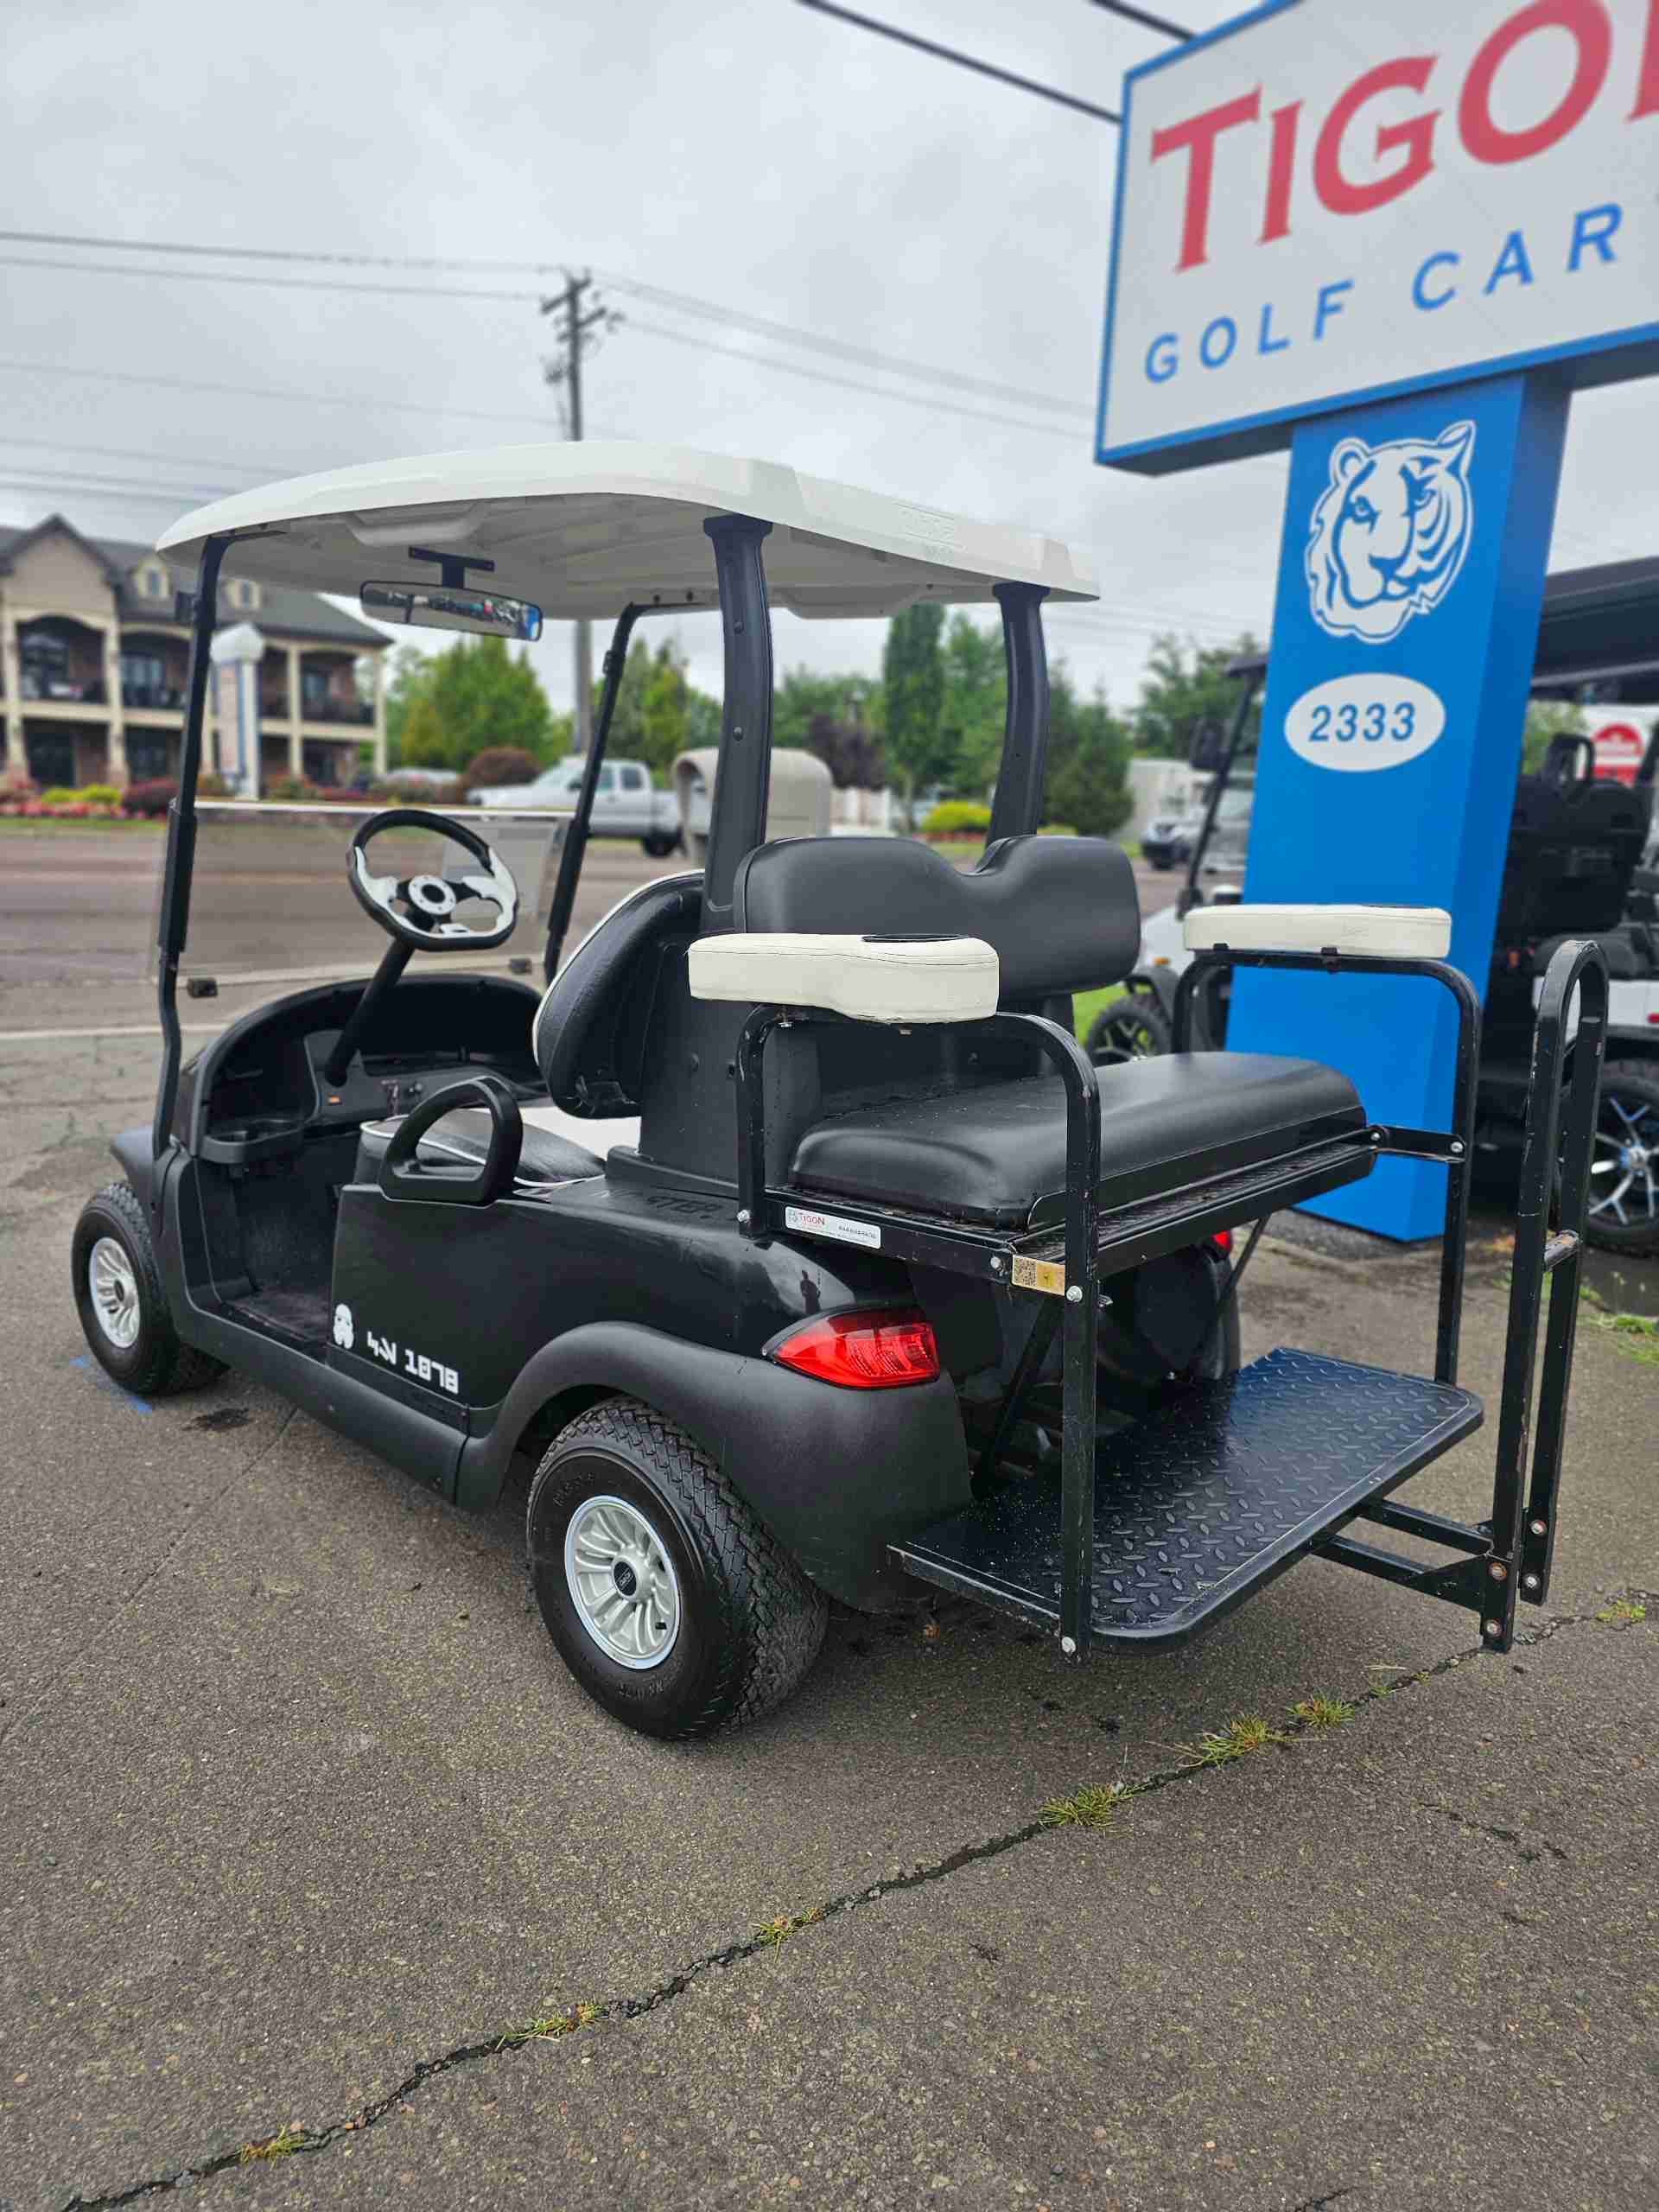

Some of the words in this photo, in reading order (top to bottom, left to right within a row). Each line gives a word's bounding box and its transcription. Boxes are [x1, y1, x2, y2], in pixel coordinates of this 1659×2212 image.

[1151, 0, 1659, 271] TIGO
[1143, 276, 1356, 385] GOLF
[1307, 700, 1417, 744] 2333
[404, 1348, 460, 1395] 1078
